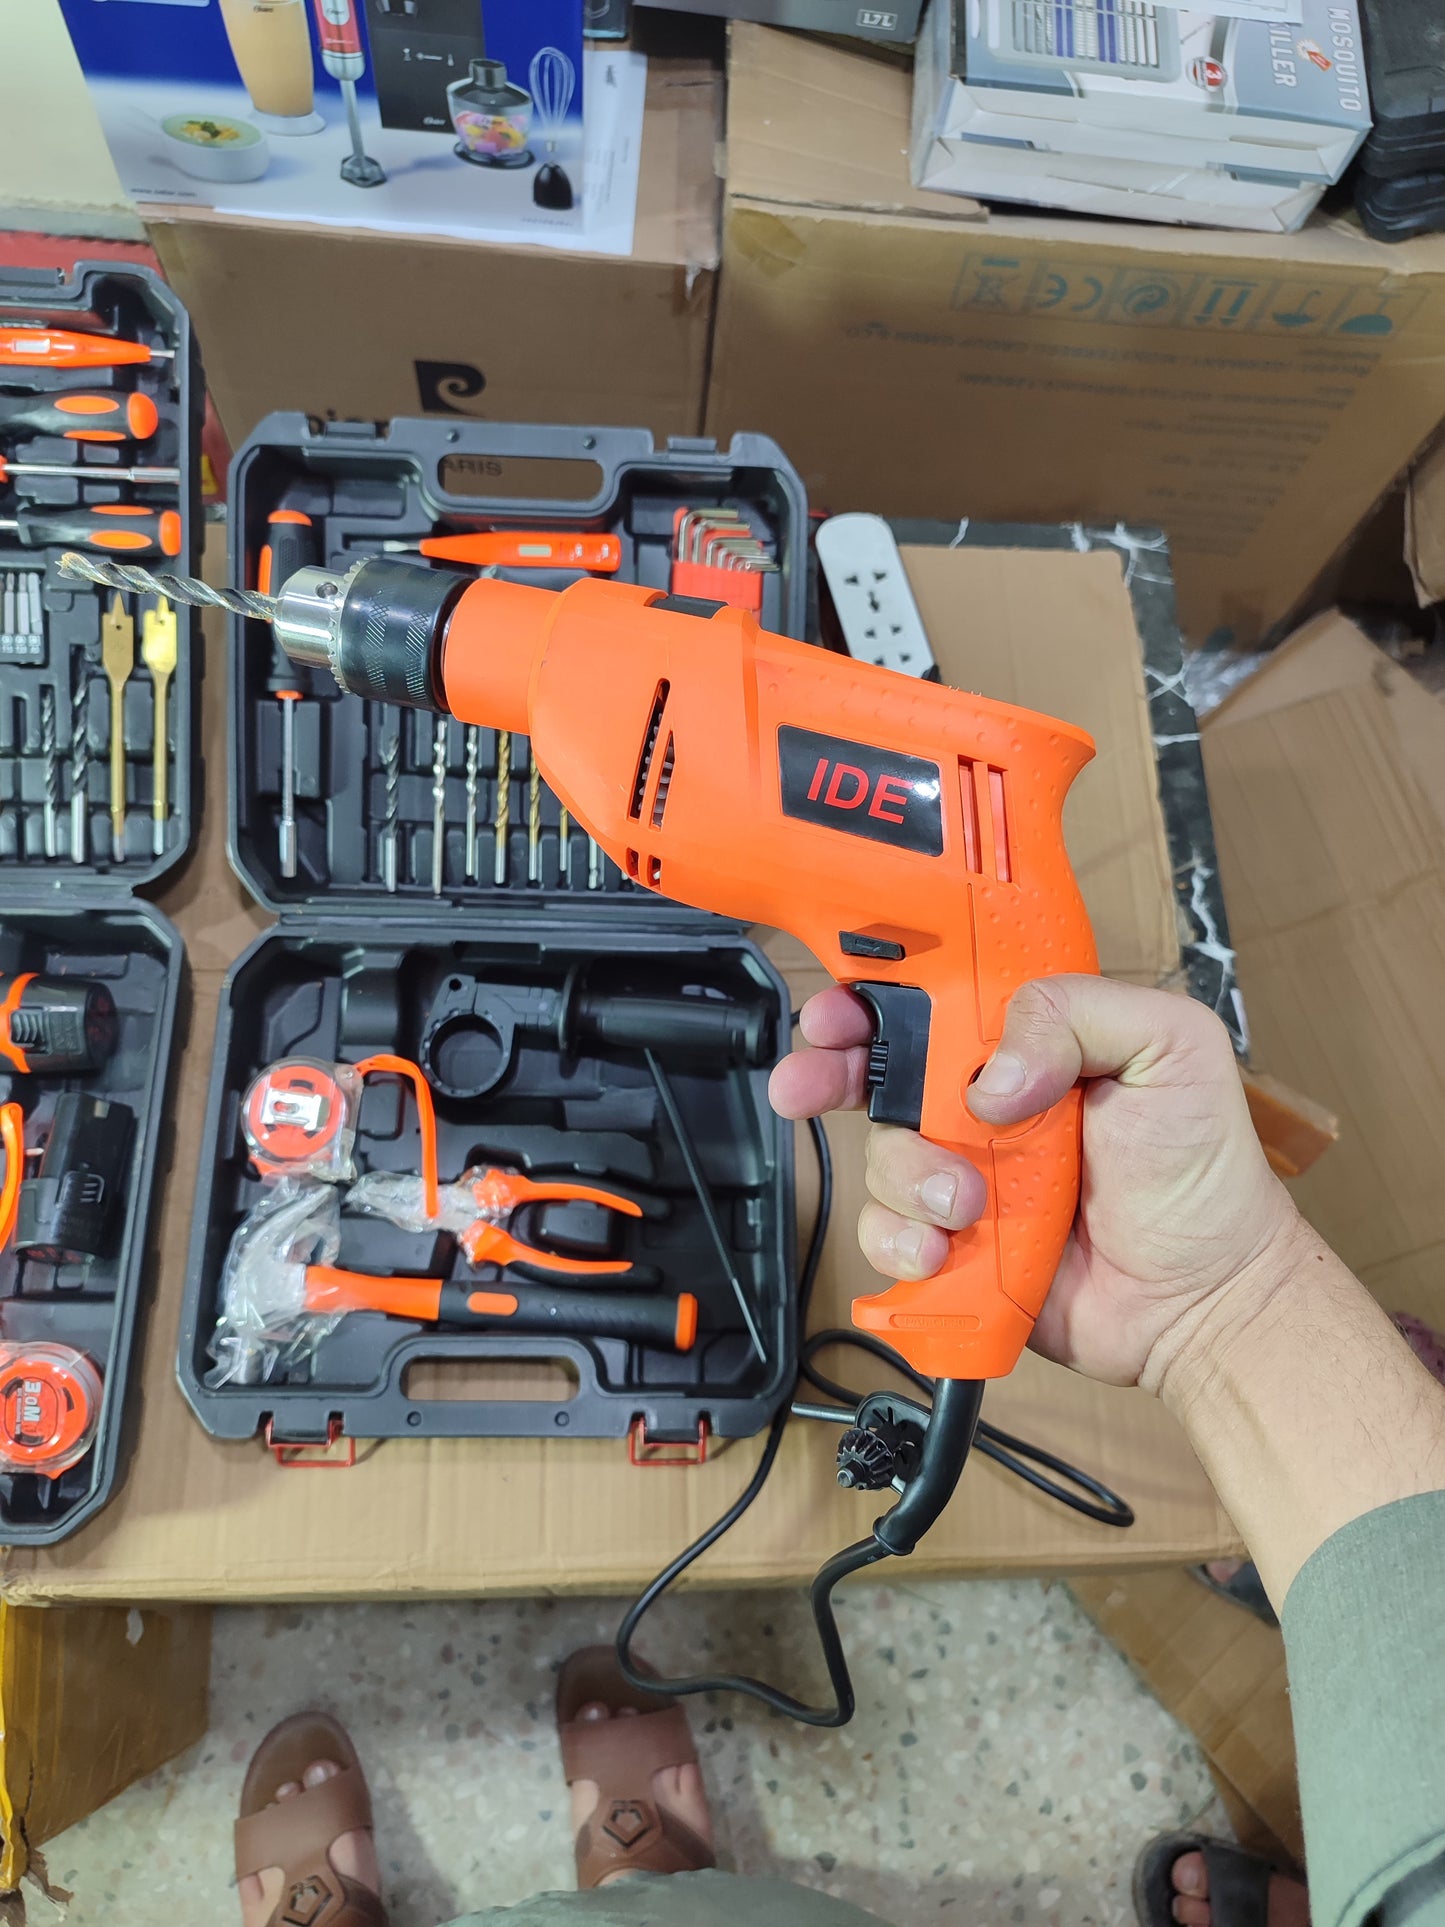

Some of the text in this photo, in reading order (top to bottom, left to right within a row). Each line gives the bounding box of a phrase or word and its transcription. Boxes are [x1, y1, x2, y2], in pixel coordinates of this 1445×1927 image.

[1327, 7, 1362, 112] MOSQUITO
[443, 459, 503, 476] ARIS
[806, 758, 914, 825] IDE
